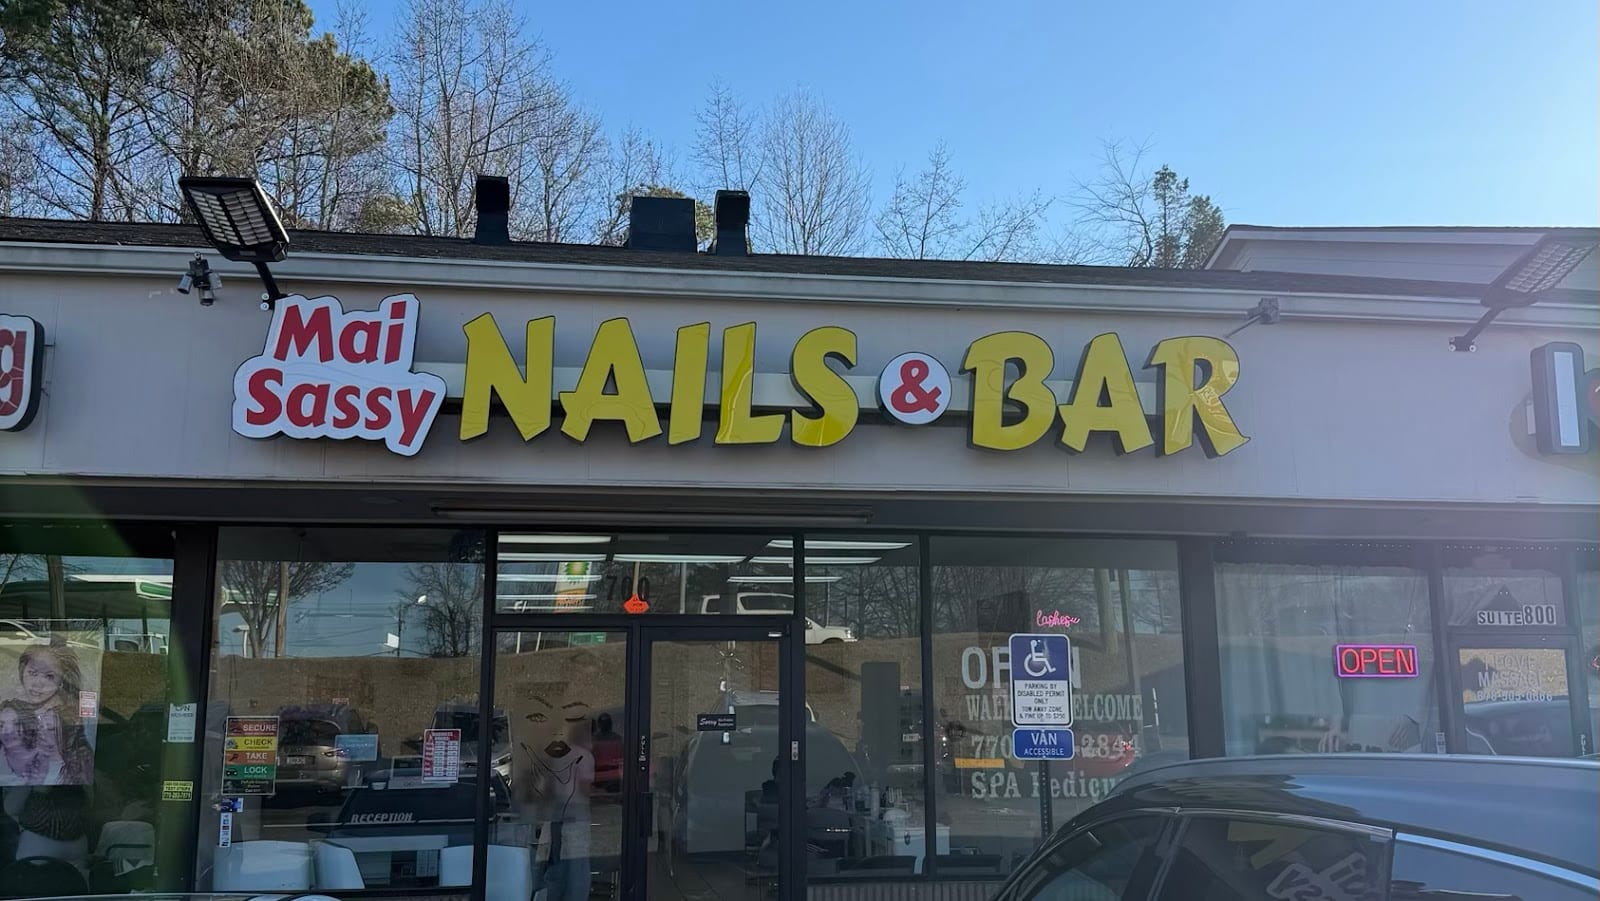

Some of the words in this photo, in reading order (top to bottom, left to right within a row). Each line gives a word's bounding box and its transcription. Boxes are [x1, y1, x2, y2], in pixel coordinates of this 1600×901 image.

[274, 301, 408, 365] Mai
[459, 312, 859, 448] NAILS
[890, 358, 942, 415] &
[963, 330, 1251, 458] BAR
[246, 367, 437, 447] Sassy
[1478, 611, 1522, 625] SUITE
[1524, 605, 1555, 624] 800
[1341, 648, 1414, 674] OPEN
[965, 694, 1012, 721] WAL
[1073, 694, 1143, 721] ELCOME
[242, 723, 278, 732] SECURE
[243, 738, 273, 746] CHECK
[1031, 732, 1057, 745] VAN
[245, 752, 268, 760] TAKE
[1024, 748, 1065, 756] ACCESSIBLE
[243, 766, 268, 774] LOCK
[971, 771, 1021, 799] SPA
[350, 811, 413, 824] RECEPTION
